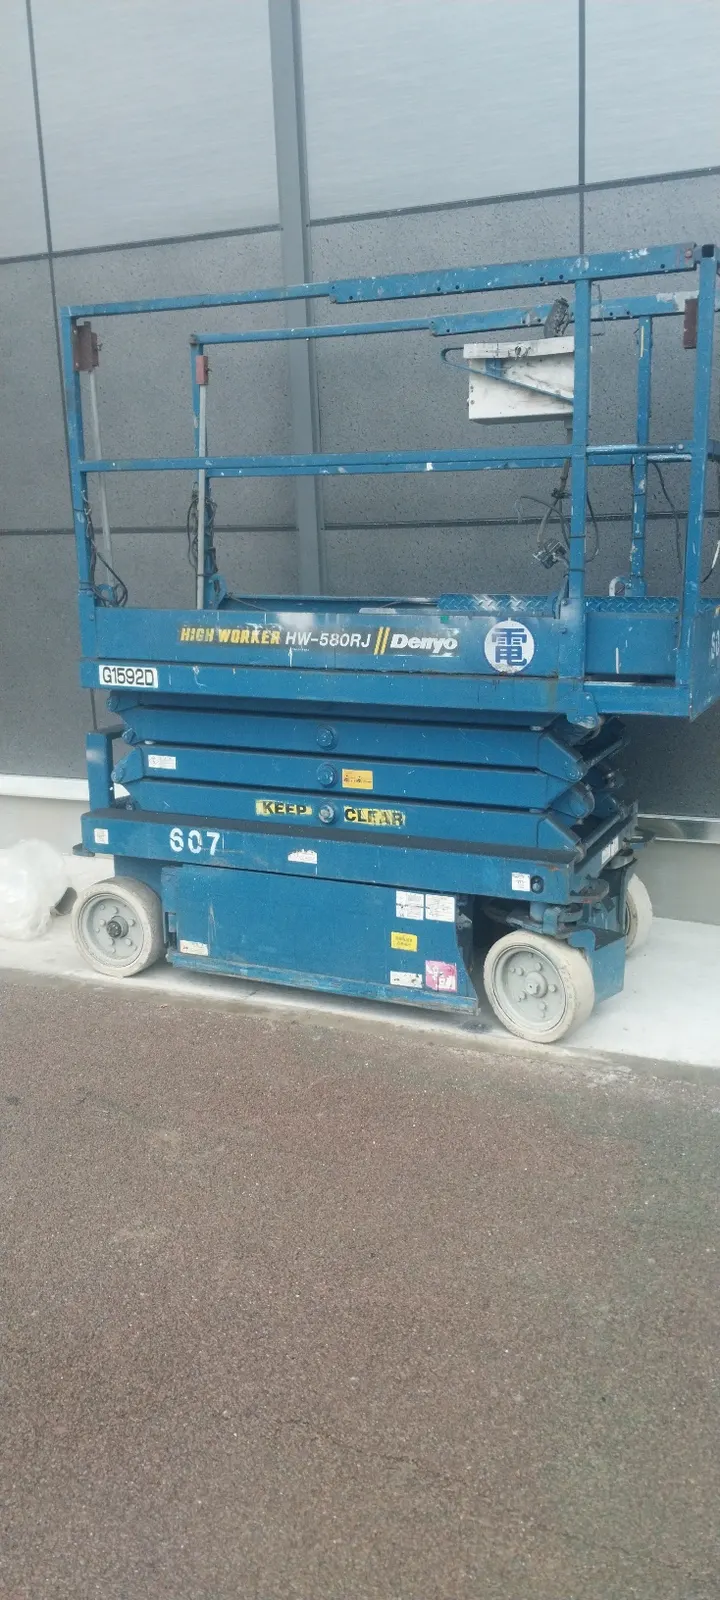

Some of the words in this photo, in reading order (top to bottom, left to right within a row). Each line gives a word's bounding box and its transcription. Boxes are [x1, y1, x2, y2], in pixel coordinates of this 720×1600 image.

[180, 626, 214, 642] HIGH
[218, 628, 281, 645] WORKER
[285, 632, 371, 648] HW-580RJ
[391, 634, 458, 653] Denyo
[491, 628, 528, 666] 電
[102, 667, 154, 686] G1592D
[262, 800, 307, 816] KEEP
[344, 808, 404, 826] CLEAR
[169, 827, 219, 856] 607
